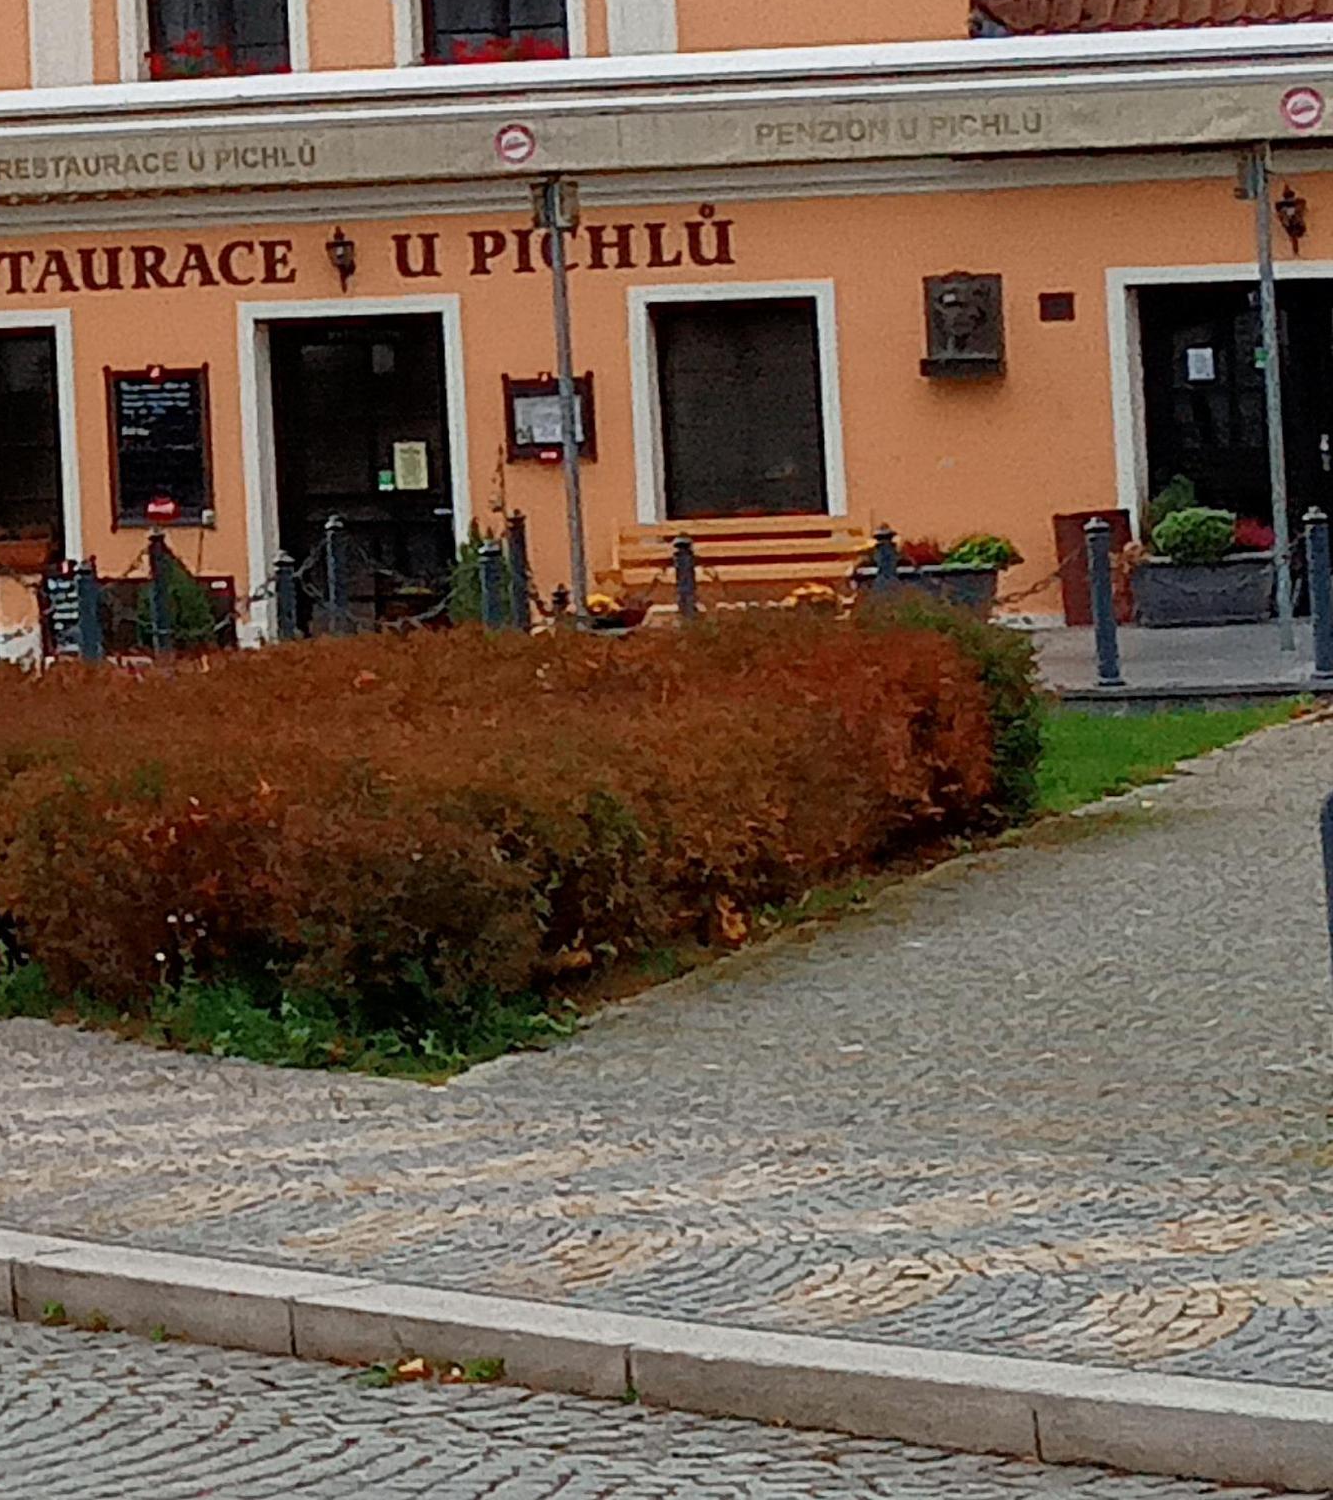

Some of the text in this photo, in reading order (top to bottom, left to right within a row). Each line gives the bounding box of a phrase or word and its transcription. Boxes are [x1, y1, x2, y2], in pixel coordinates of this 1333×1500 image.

[755, 118, 890, 145] PENZION
[900, 116, 918, 141] U
[188, 150, 205, 172] U
[215, 138, 316, 172] PICHLŮ
[391, 232, 442, 278] U
[468, 203, 736, 276] PICHLŮ
